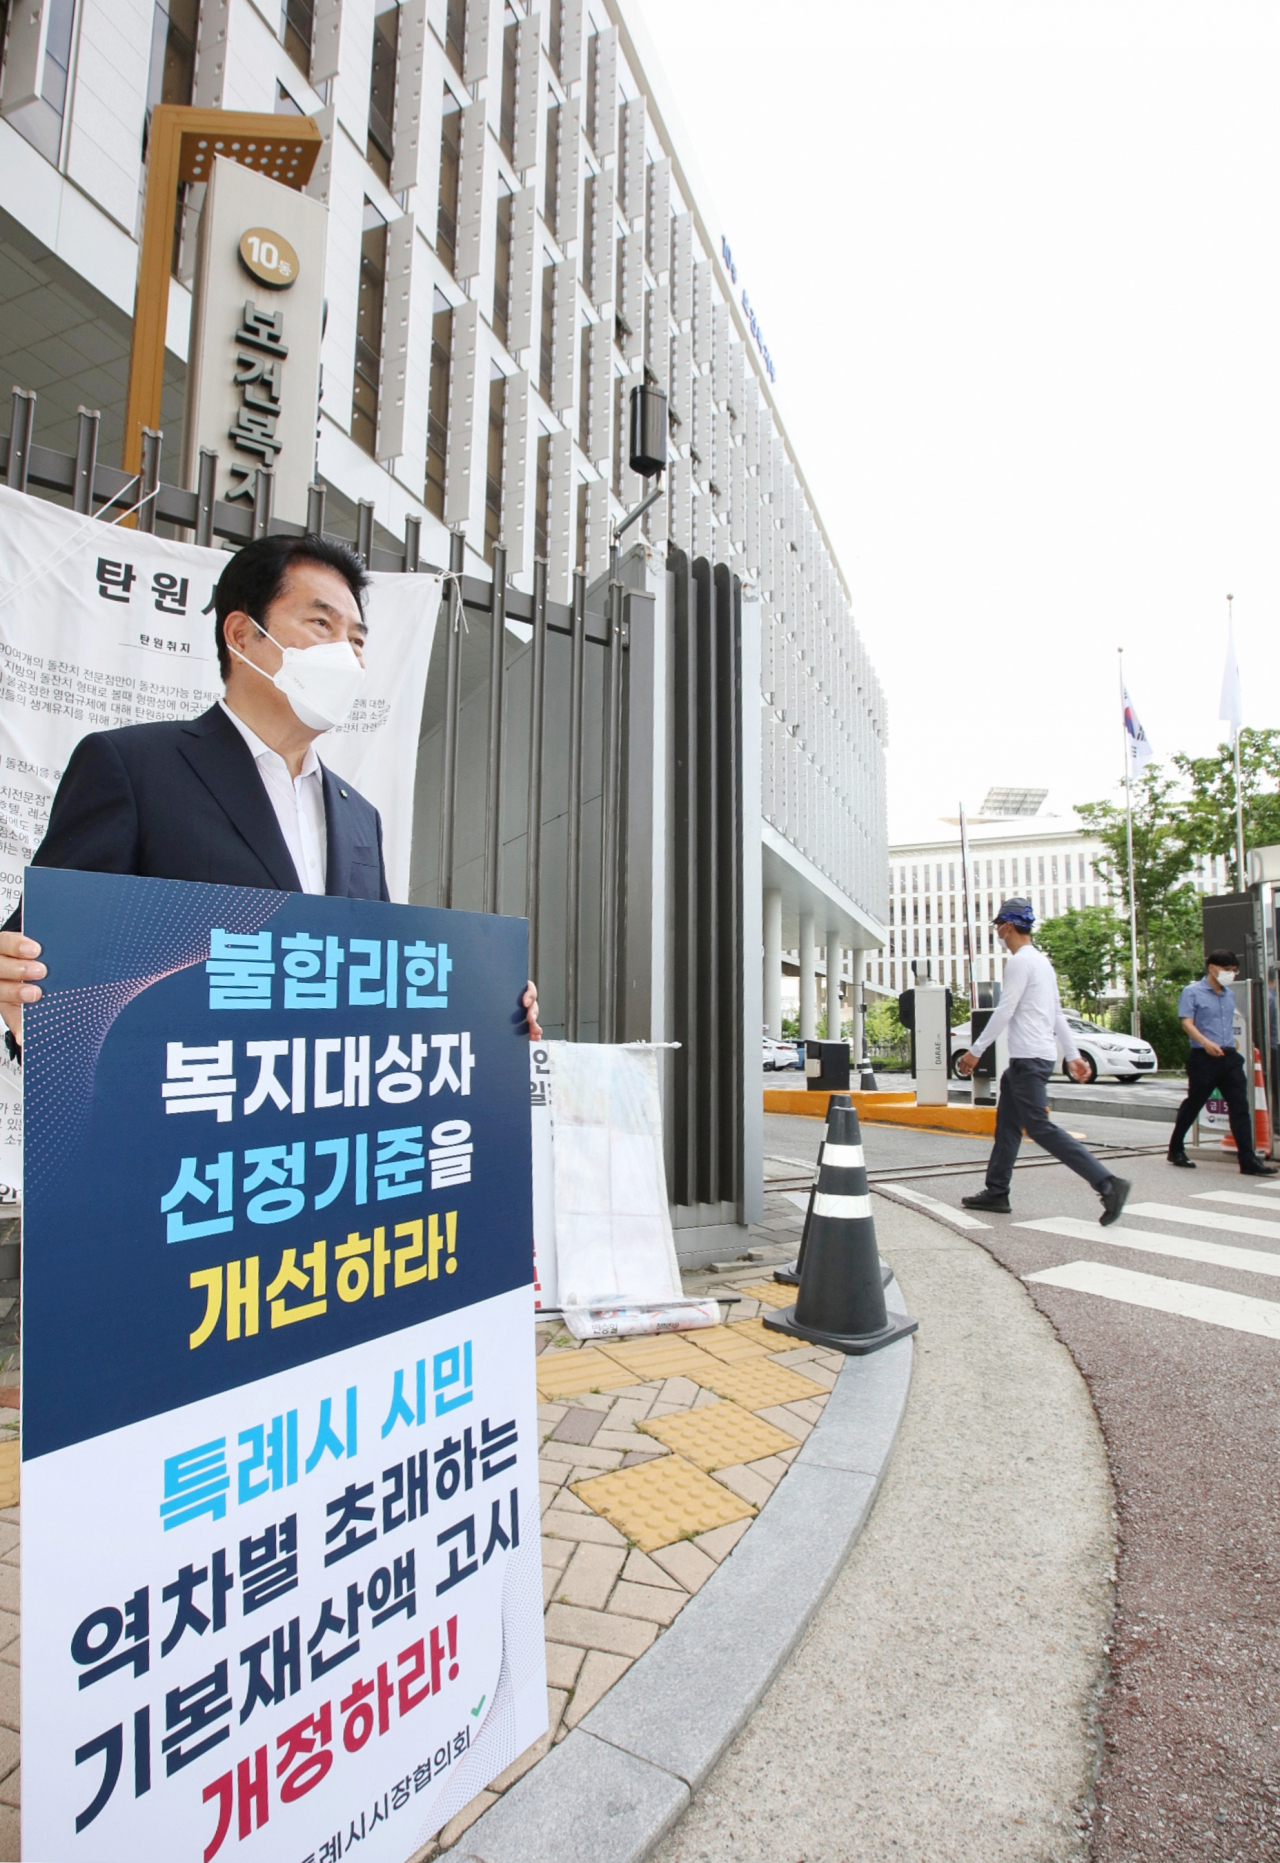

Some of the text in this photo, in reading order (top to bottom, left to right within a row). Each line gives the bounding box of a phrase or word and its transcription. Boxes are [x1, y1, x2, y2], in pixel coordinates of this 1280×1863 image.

[222, 300, 288, 551] 보건복지
[4, 659, 36, 681] 지방의
[40, 672, 72, 689] 돌잔치
[77, 681, 108, 698] 형태로
[136, 693, 176, 711] 형평성에
[47, 659, 79, 677] 돌잔치
[83, 668, 135, 688] 전문점만이
[139, 634, 190, 653] 탄원취지
[30, 698, 84, 721] 생계유지를
[88, 712, 110, 726] 위해
[53, 689, 107, 713] 영업규제에
[111, 703, 131, 715] 대해
[206, 928, 453, 1010] 불합리한
[161, 1032, 475, 1123] 복지대상자
[934, 1041, 942, 1065] DARAE
[161, 1119, 474, 1244] 선정기준을
[189, 1211, 458, 1351] 개선하라!
[160, 1340, 474, 1532] 특례시 시민
[70, 1417, 519, 1692] 역차별 초래하는
[74, 1486, 520, 1835] 기본재산액 고시
[202, 1614, 460, 1863] 개정하라!
